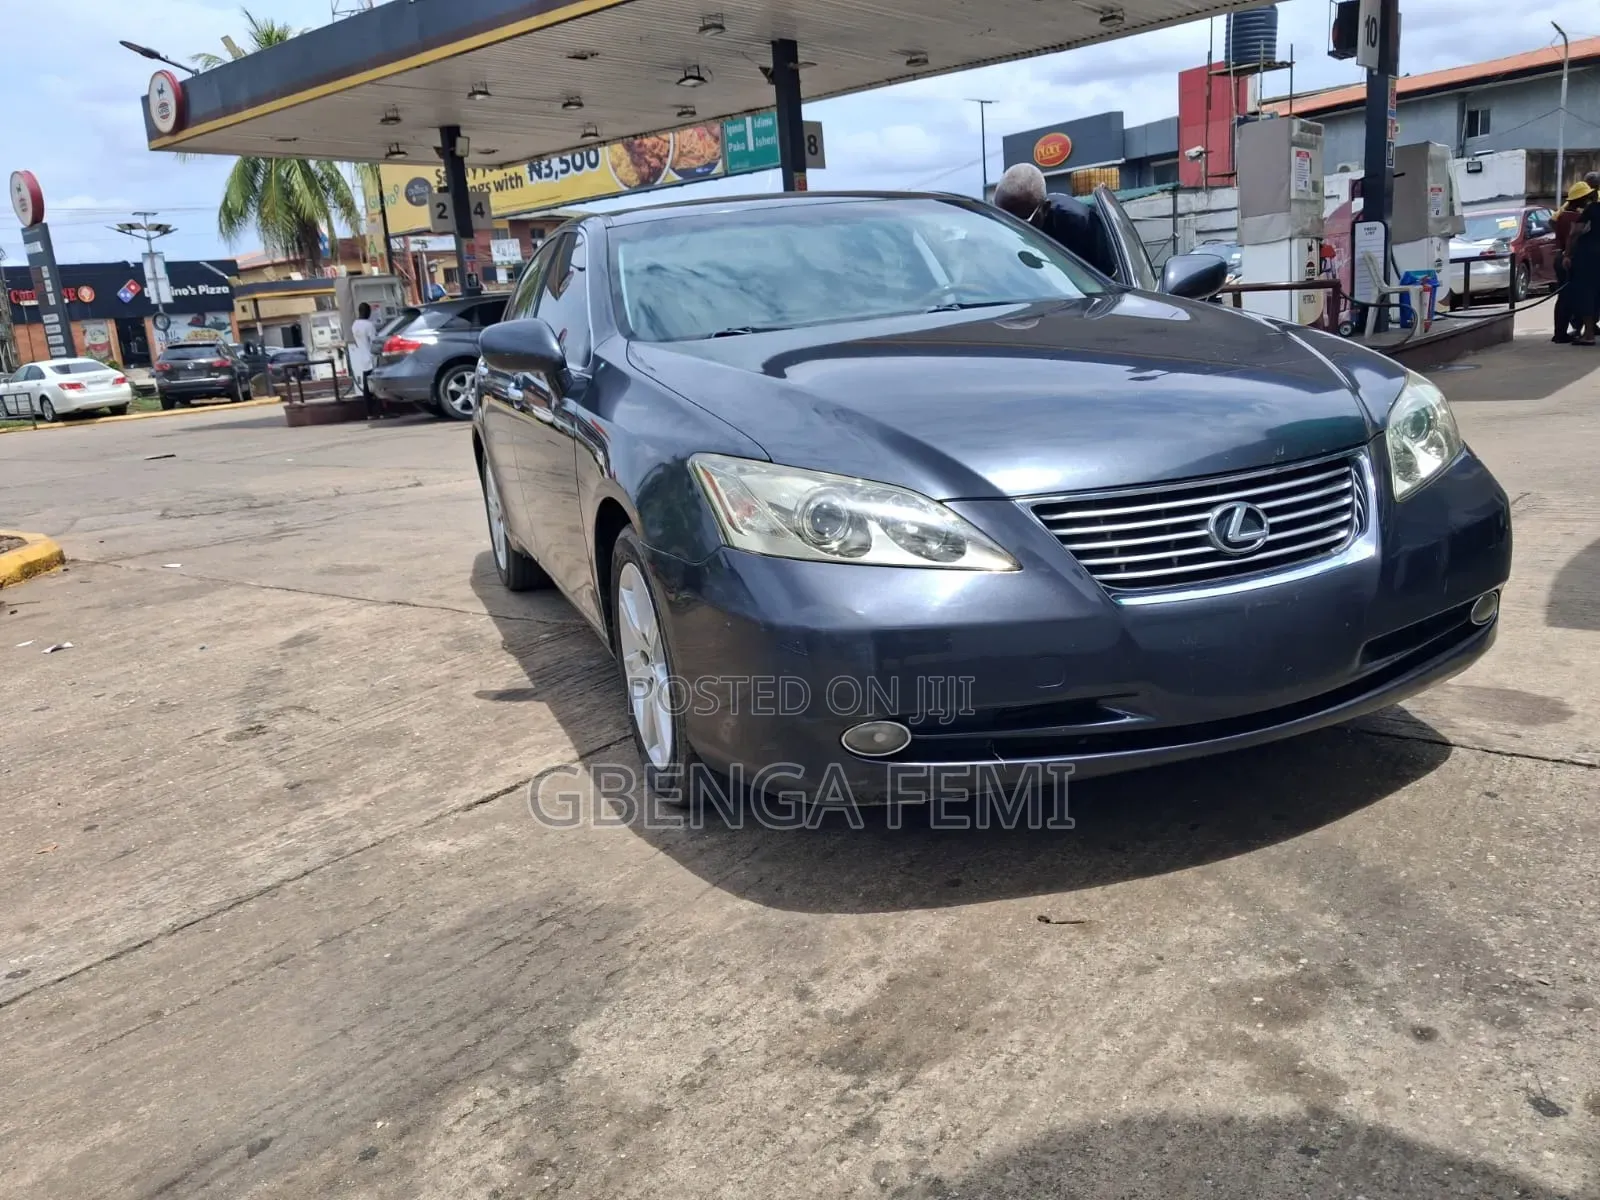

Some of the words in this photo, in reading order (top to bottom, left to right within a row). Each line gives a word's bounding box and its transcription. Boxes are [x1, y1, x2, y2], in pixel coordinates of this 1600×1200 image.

[1364, 14, 1378, 48] 10
[807, 134, 818, 155] 8
[493, 172, 524, 192] with
[436, 203, 449, 219] 2
[473, 202, 485, 219] 4
[198, 285, 230, 295] Pizza
